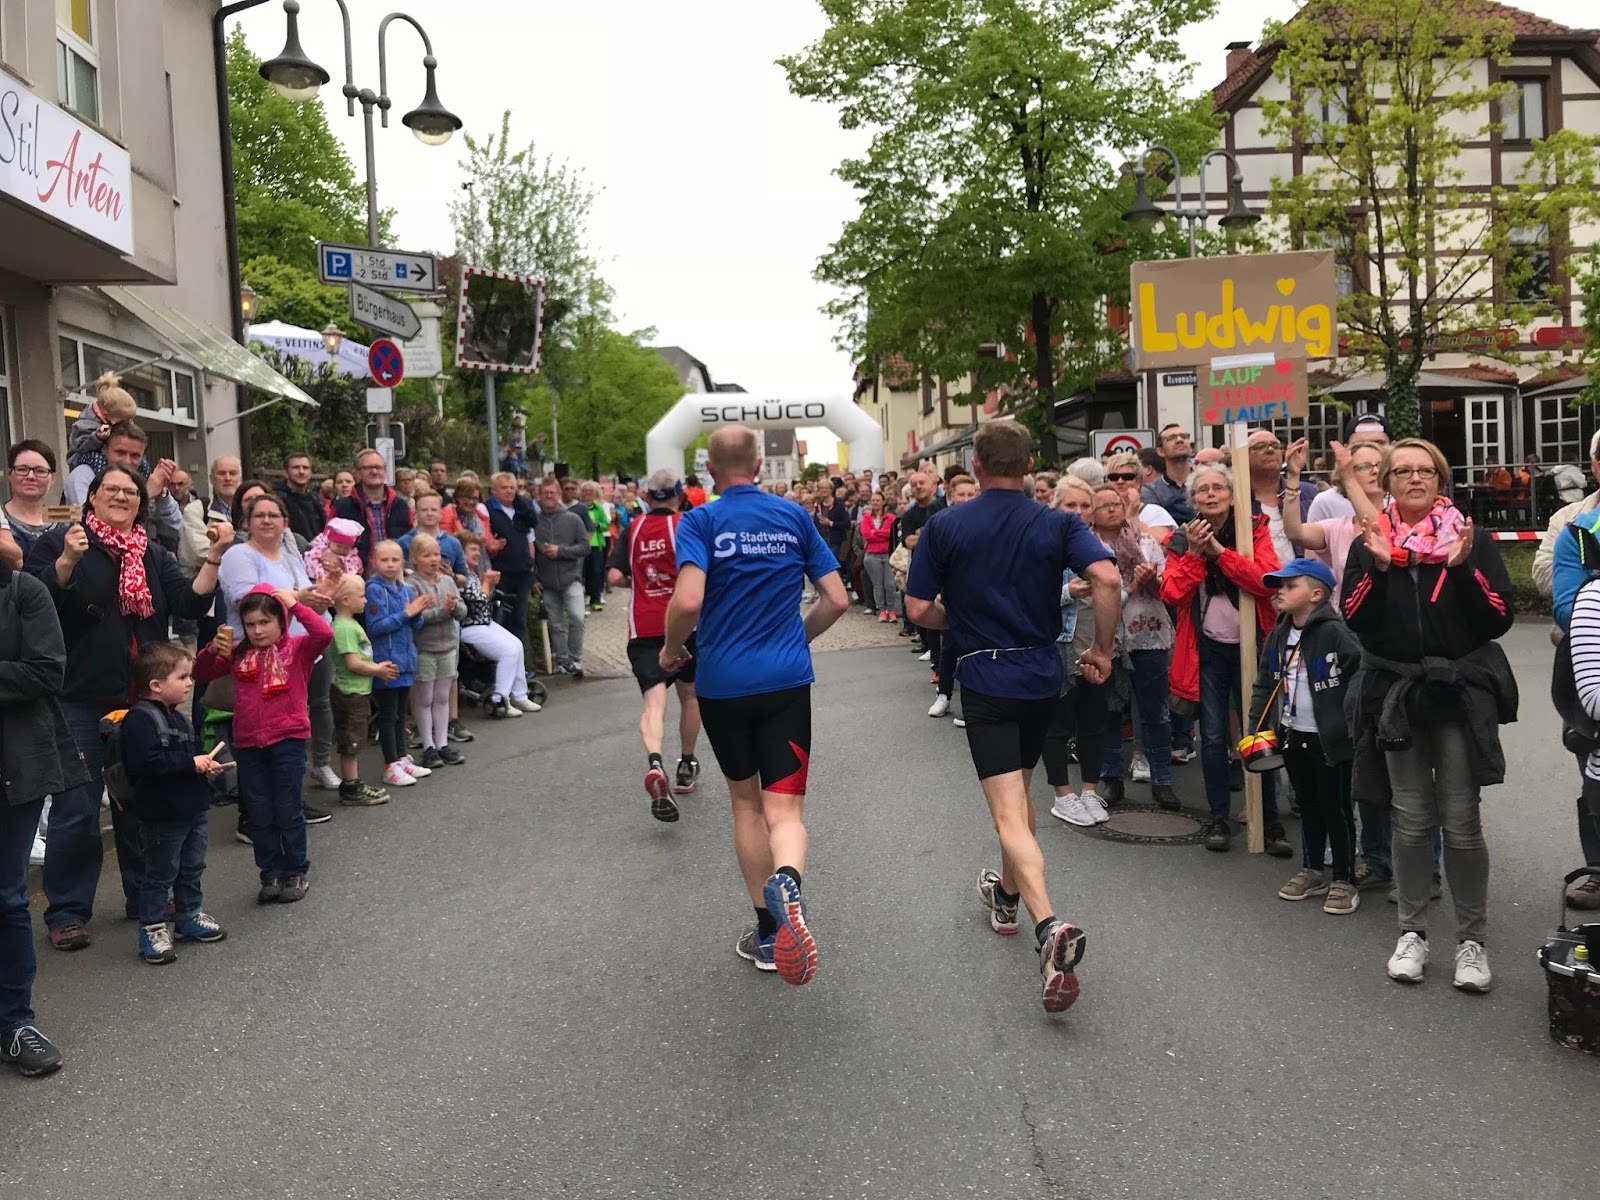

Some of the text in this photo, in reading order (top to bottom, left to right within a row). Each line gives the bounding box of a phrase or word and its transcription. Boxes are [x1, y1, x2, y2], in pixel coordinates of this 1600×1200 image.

[0, 90, 124, 222] Stil Arten
[331, 254, 346, 275] P
[357, 293, 406, 327] Bürgerhaus
[1139, 277, 1331, 357] Ludwig
[285, 338, 325, 349] VELTINS
[1209, 365, 1264, 386] LAUF
[1214, 382, 1296, 407] LUDWIG
[701, 400, 825, 422] SCHÜCO
[640, 538, 666, 552] LEG
[740, 531, 798, 544] Stadtwerke
[741, 543, 787, 555] Bielefeld
